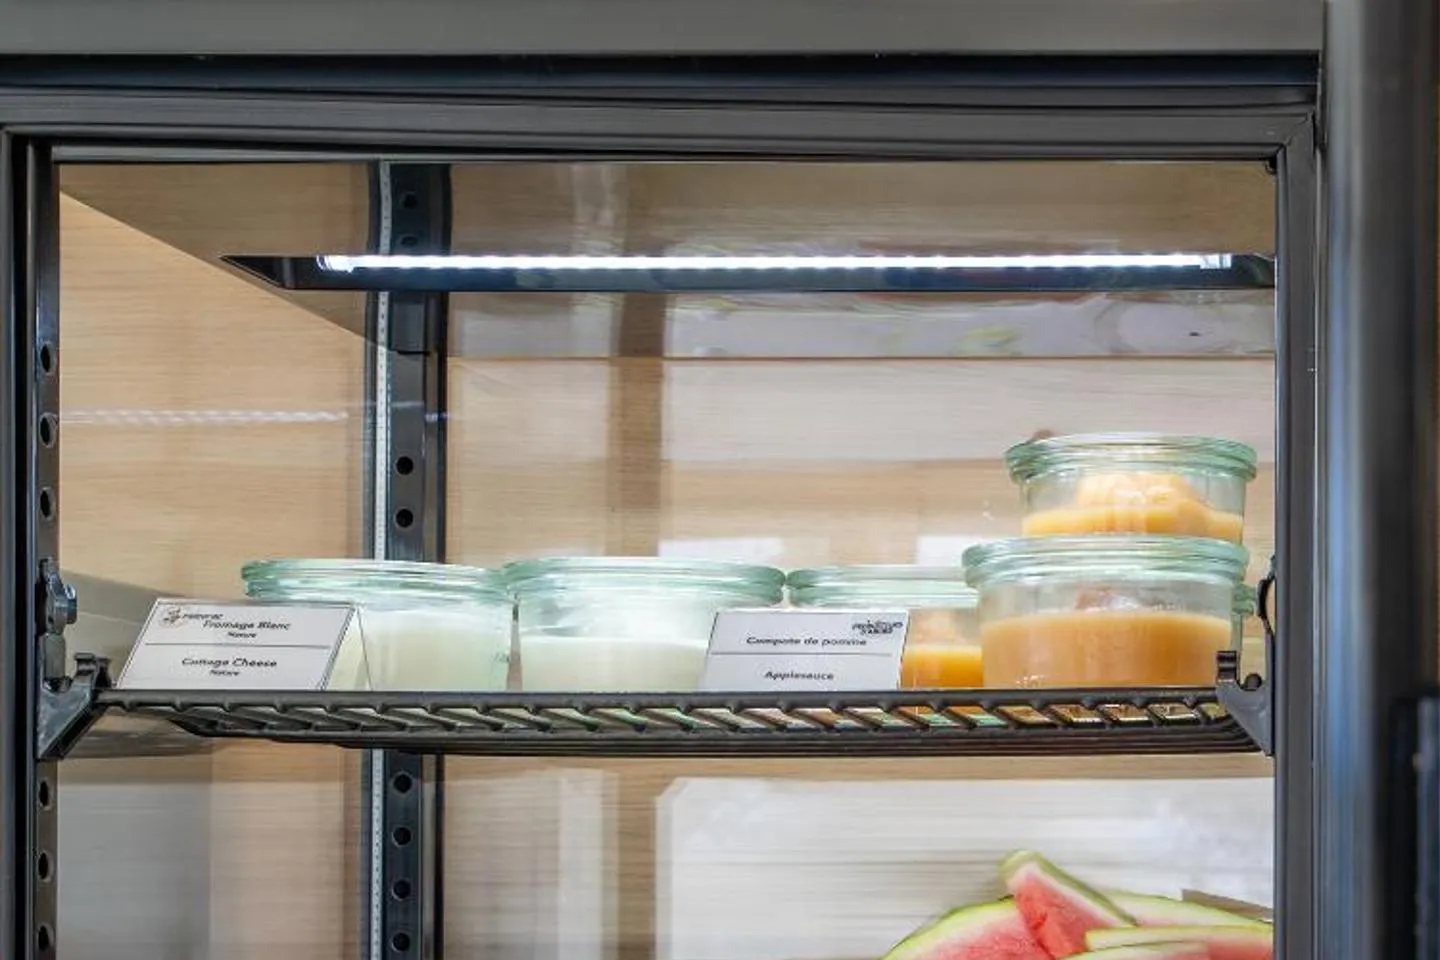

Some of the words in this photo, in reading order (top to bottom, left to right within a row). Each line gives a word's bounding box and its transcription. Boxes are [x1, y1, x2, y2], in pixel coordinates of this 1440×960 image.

[203, 620, 254, 630] Fromage
[257, 621, 291, 630] Blanc
[746, 636, 800, 646] Compote
[804, 637, 818, 645] de
[822, 638, 867, 648] pomme
[181, 657, 229, 668] Cottage
[232, 657, 277, 667] Cheese
[764, 671, 834, 681] Applesauce
